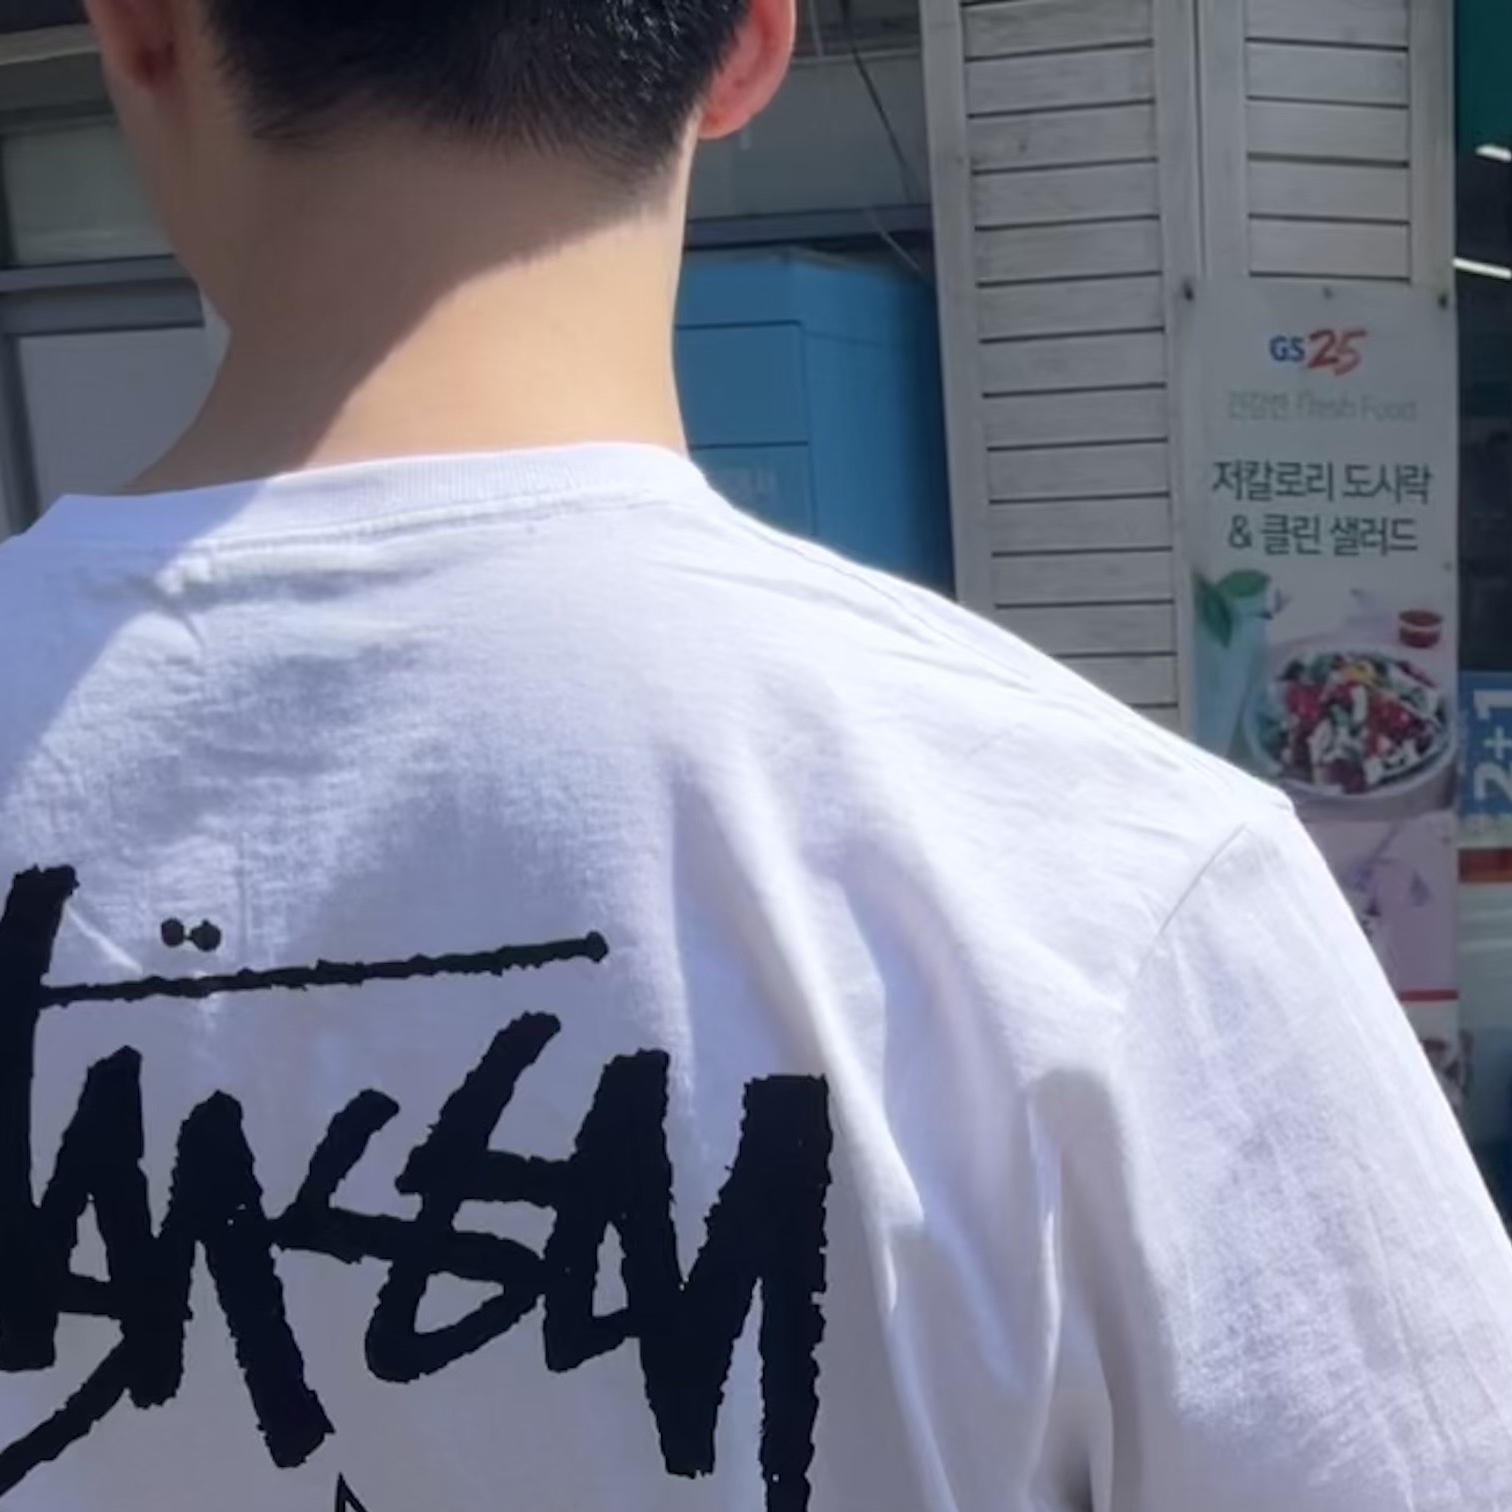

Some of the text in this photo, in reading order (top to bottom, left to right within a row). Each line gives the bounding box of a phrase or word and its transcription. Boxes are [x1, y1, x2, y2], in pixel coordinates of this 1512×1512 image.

[1269, 329, 1368, 377] GS25
[1212, 460, 1433, 504] 저칼로리 도시락
[1228, 514, 1418, 556] & 클린 샐러드
